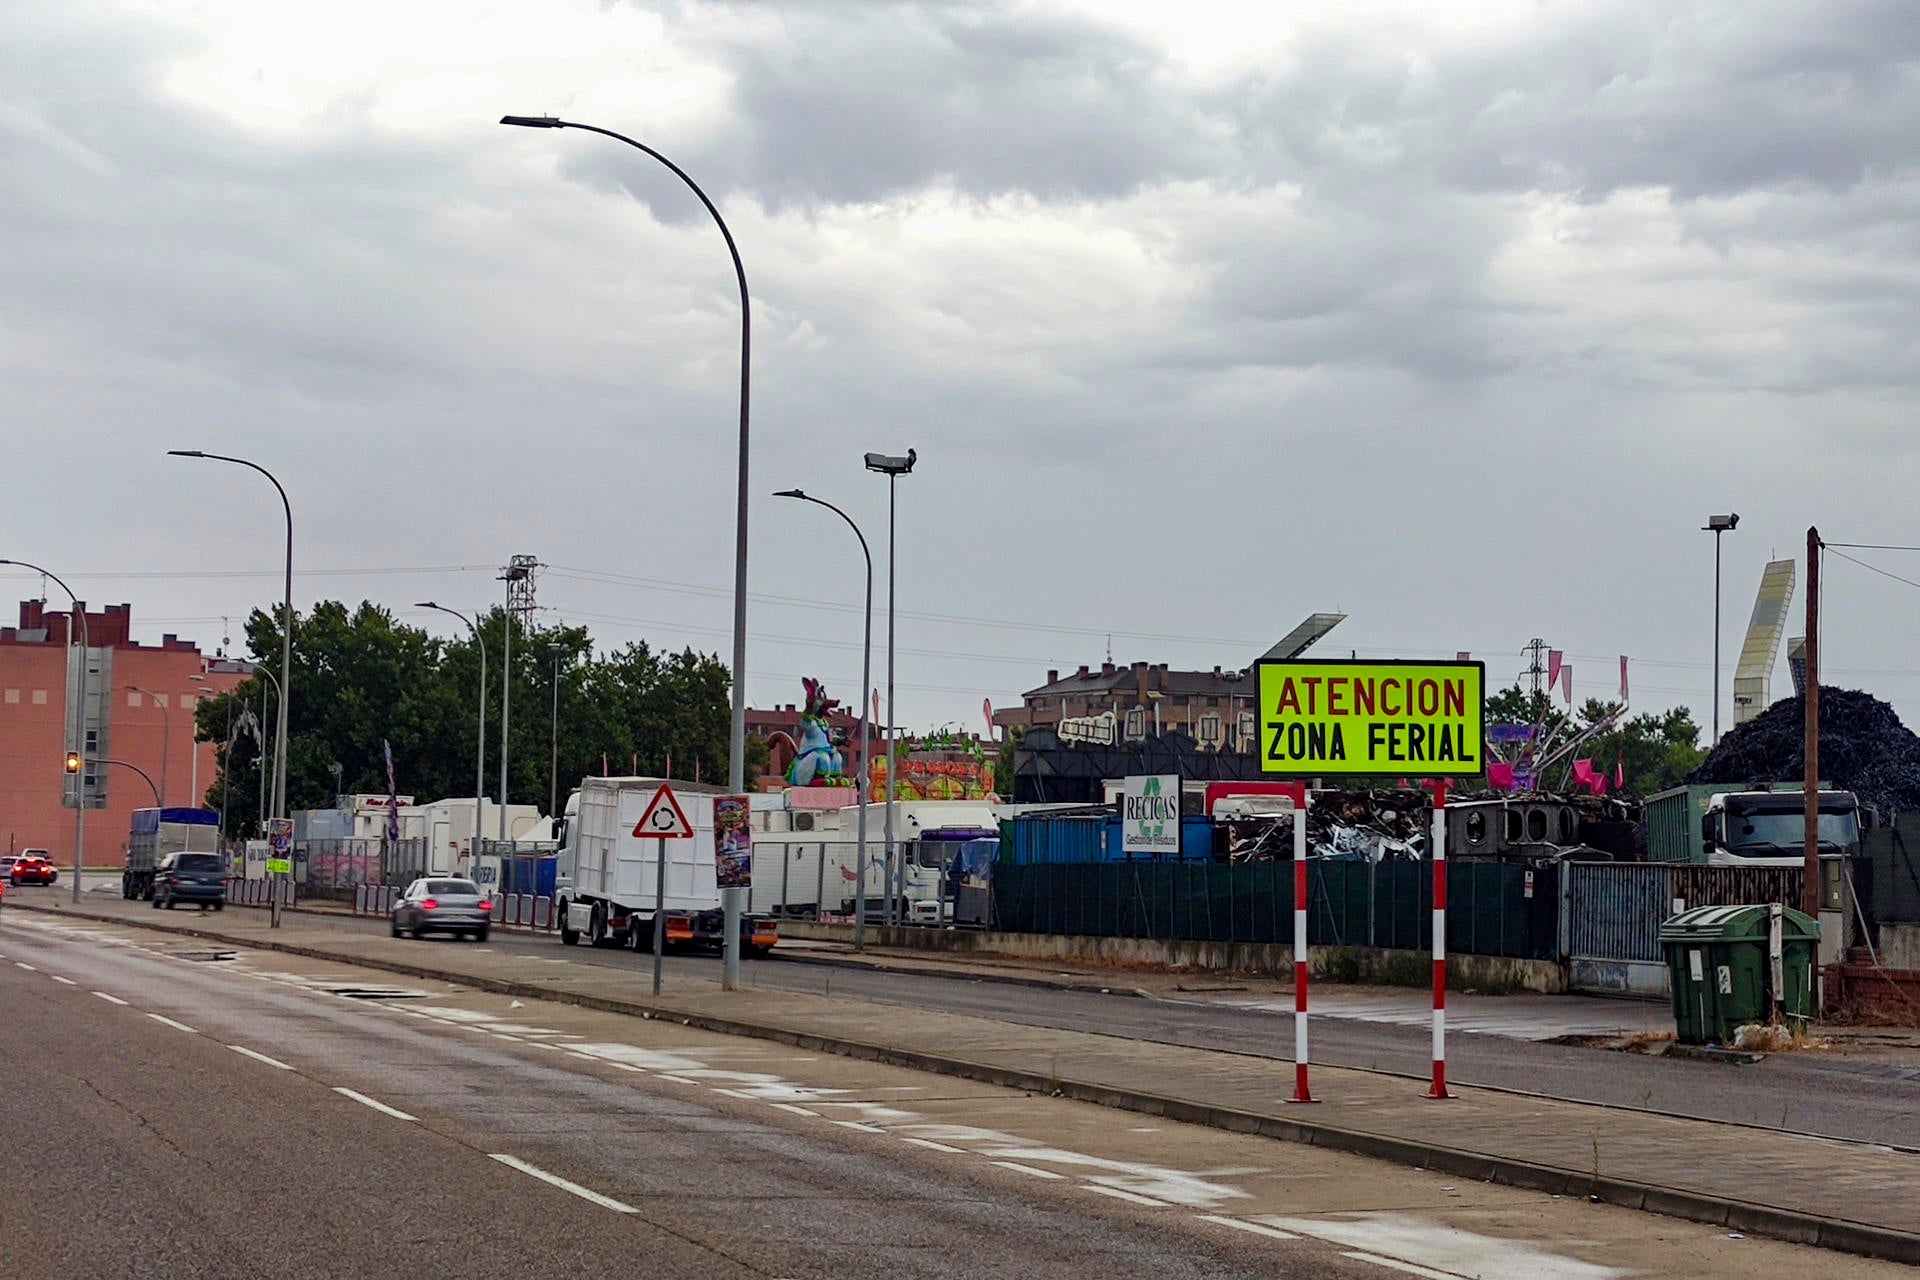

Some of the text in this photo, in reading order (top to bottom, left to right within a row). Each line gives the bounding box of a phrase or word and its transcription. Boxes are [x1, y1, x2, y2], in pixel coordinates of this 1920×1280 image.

[1276, 677, 1464, 717] ATENCION
[1267, 722, 1475, 762] ZONA FERIAL
